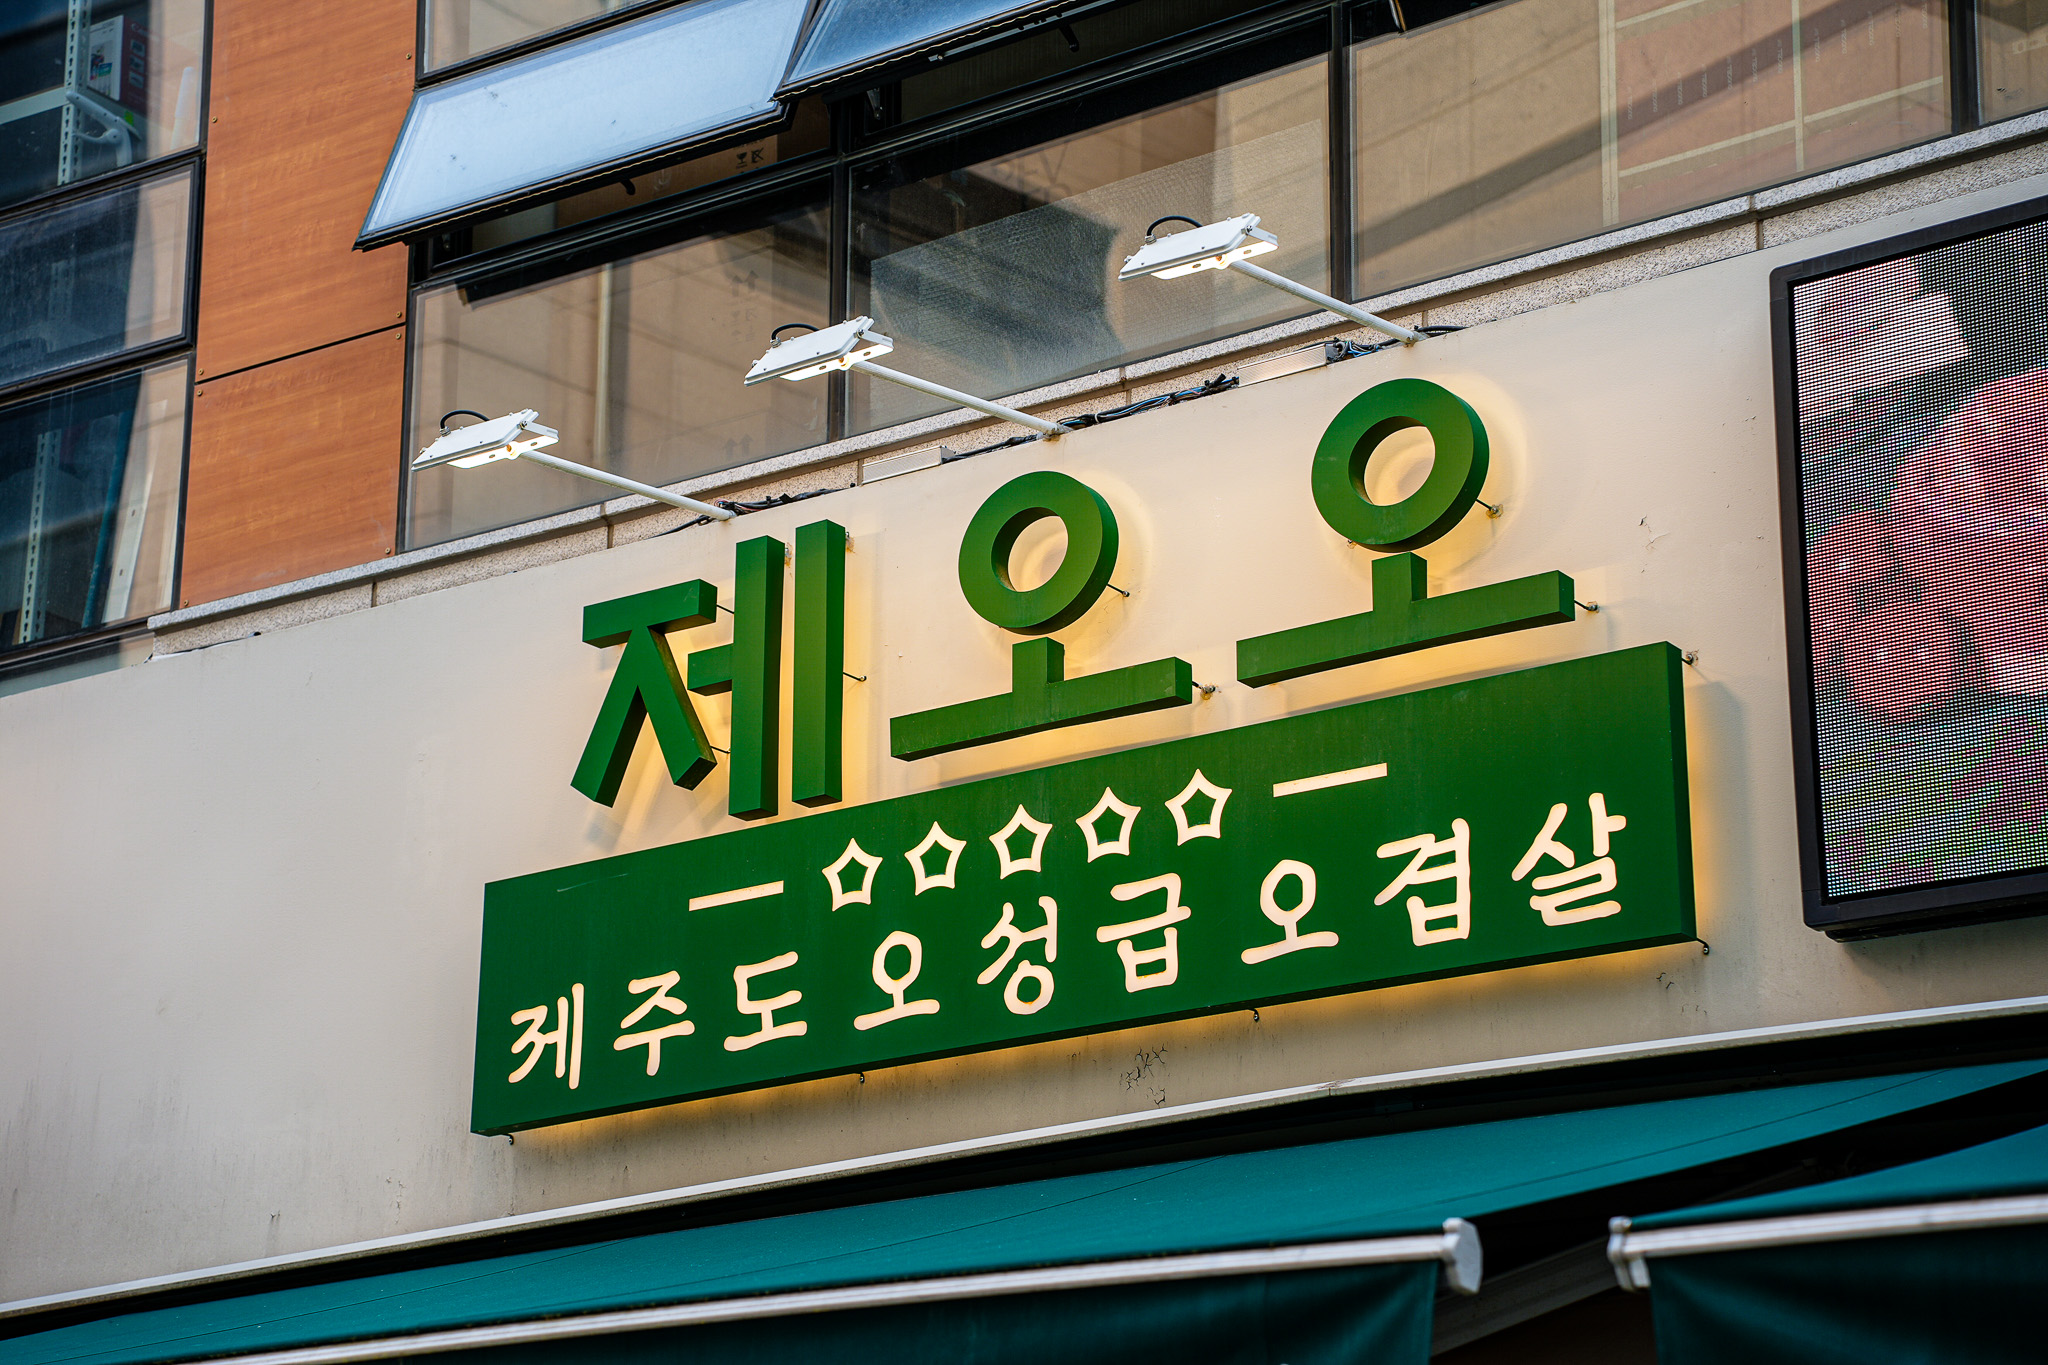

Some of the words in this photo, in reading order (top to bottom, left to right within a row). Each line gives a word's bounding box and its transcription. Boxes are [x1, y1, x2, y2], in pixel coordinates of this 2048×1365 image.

[570, 378, 1575, 821] 제오오
[508, 951, 807, 1089] 제주도
[853, 873, 1191, 1030] 오성급
[1241, 793, 1627, 964] 오겹살
